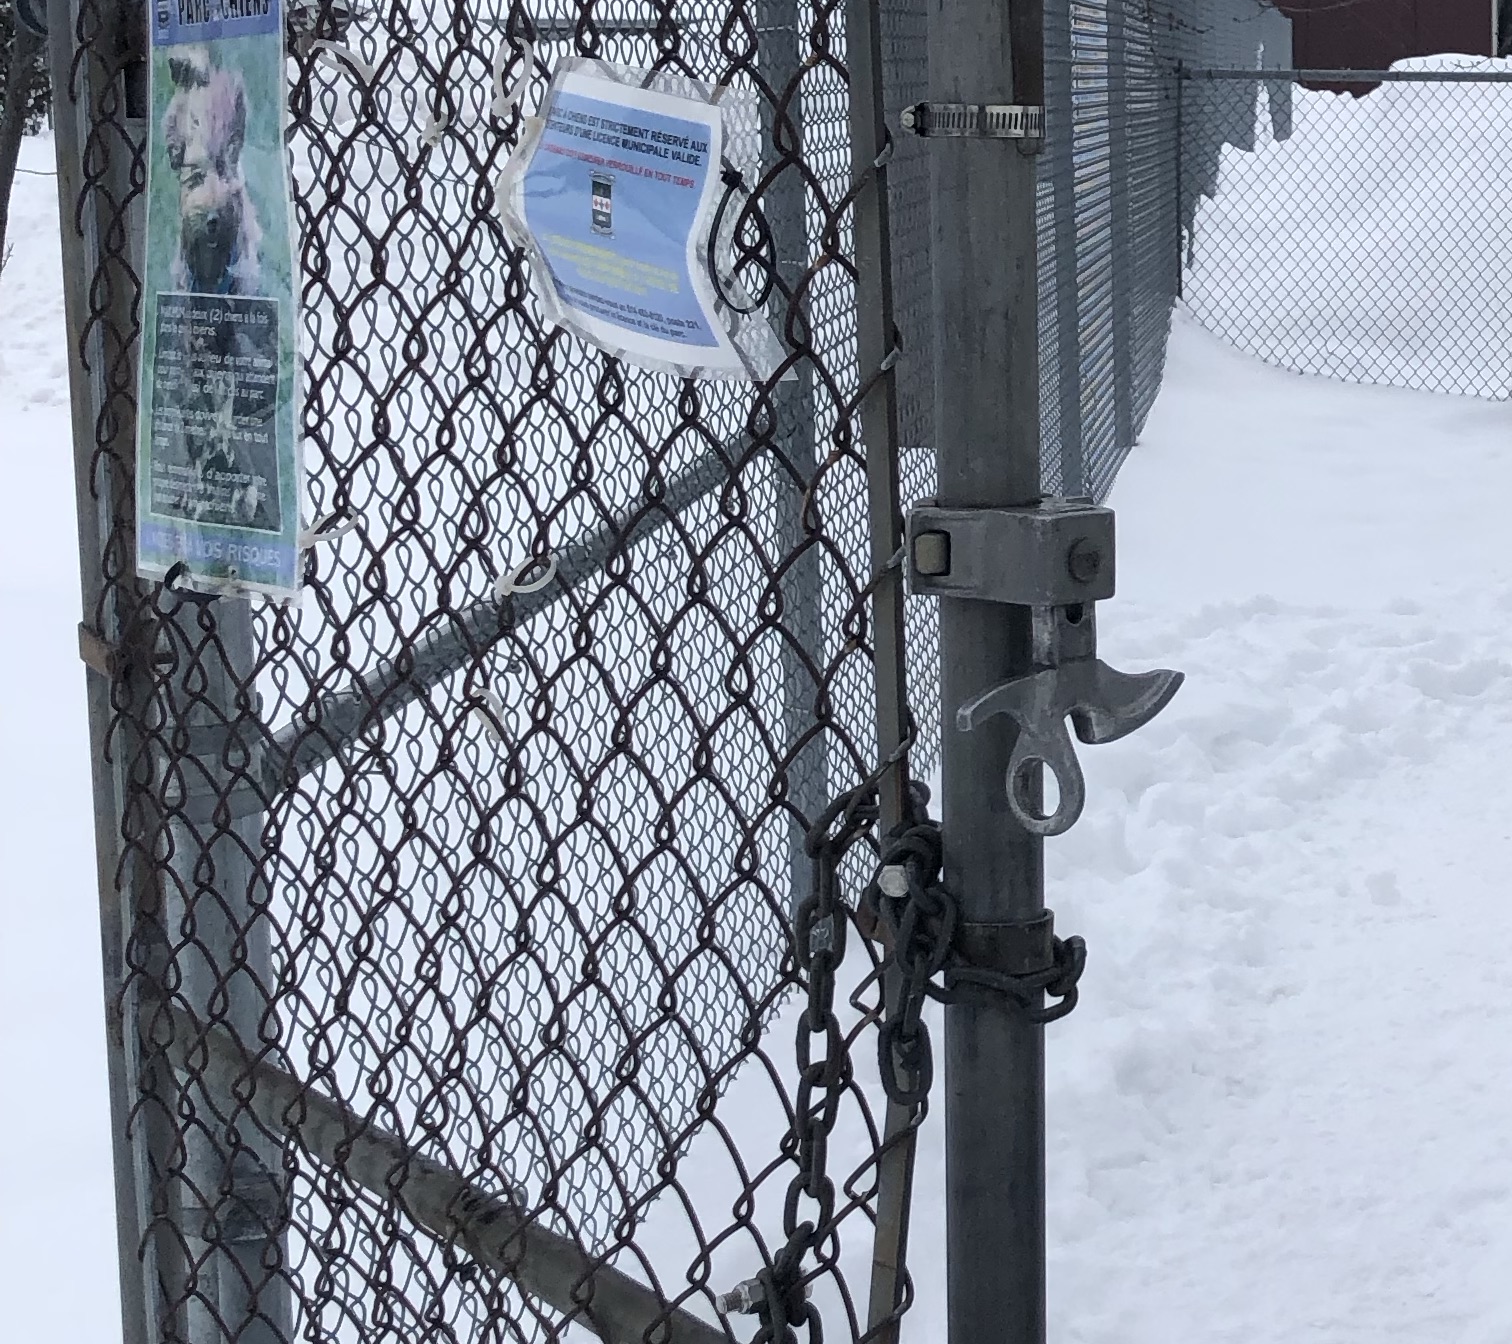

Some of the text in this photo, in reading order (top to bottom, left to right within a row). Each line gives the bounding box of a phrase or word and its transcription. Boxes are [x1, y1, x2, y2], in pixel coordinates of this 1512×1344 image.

[593, 131, 620, 147] LICENCE
[622, 139, 670, 159] MUNICIPALE
[672, 151, 702, 166] VALIDE.
[601, 118, 650, 139] STRICTEMENT
[651, 130, 689, 149] RÉSERVÉ
[690, 140, 708, 153] AUX
[228, 544, 281, 567] RISQUES
